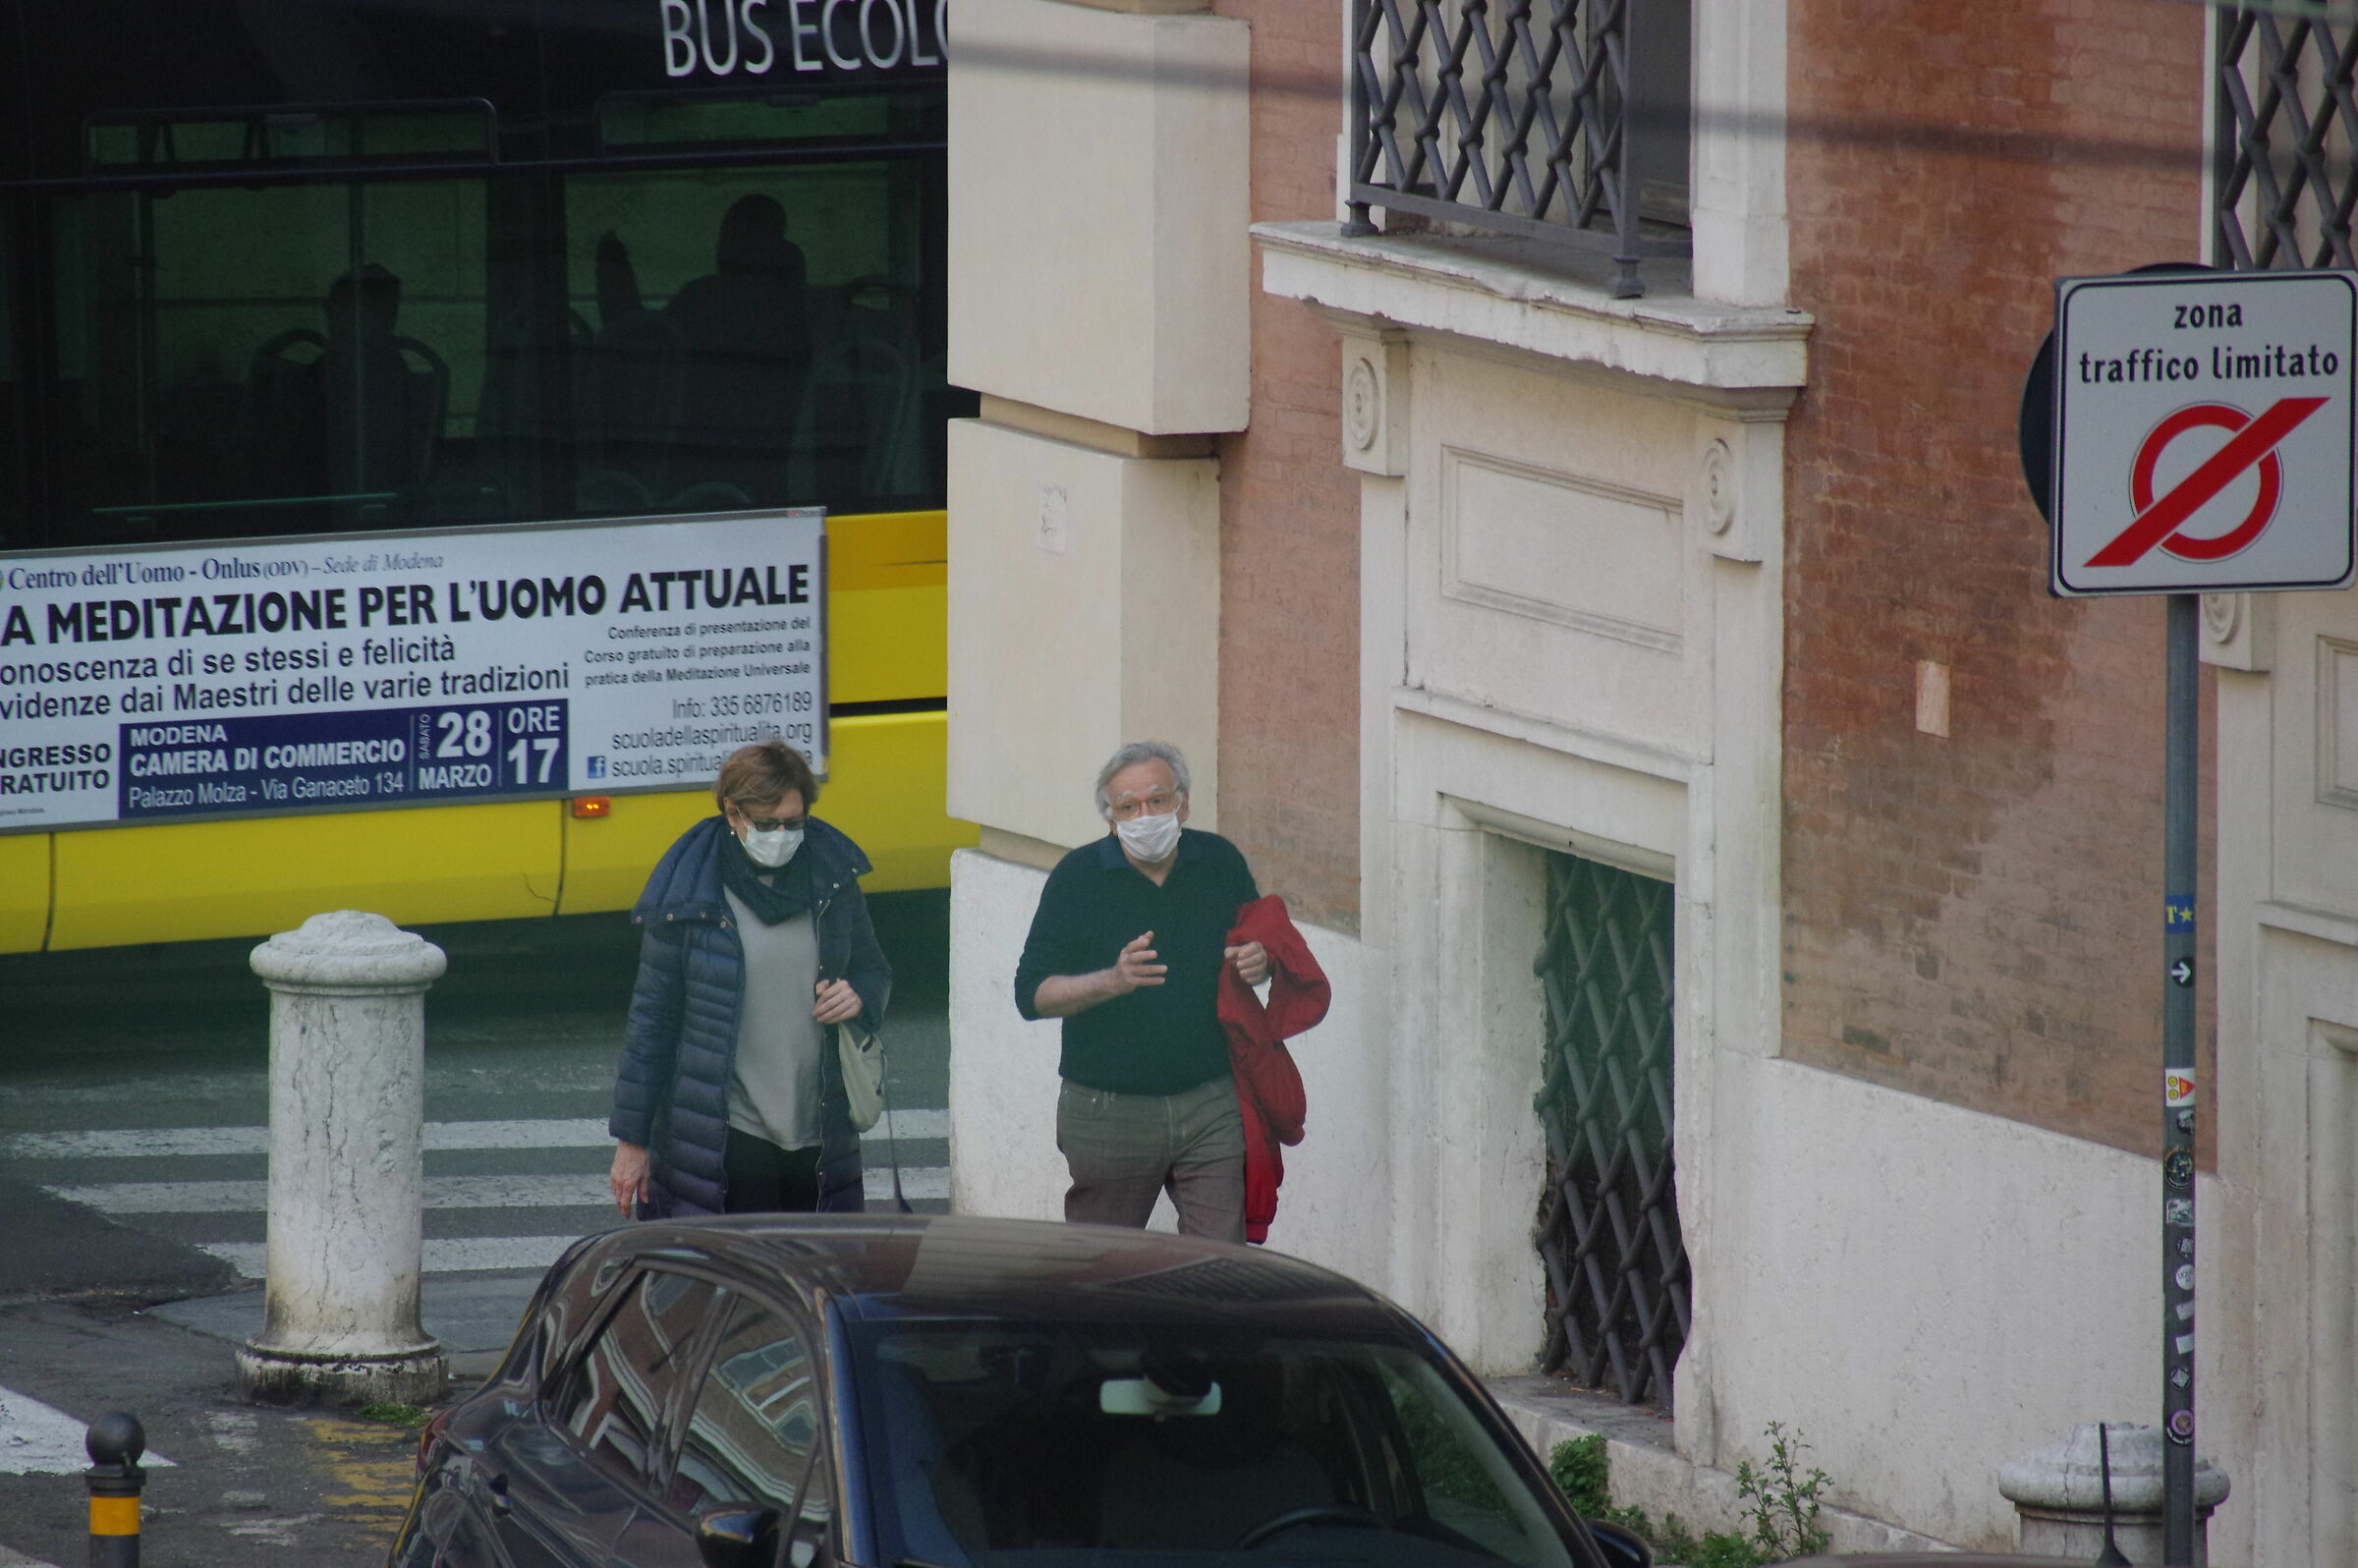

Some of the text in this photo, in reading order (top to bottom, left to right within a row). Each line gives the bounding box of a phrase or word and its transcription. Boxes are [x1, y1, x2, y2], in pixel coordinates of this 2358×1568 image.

[659, 0, 774, 78] BUS
[2173, 303, 2244, 329] zona
[2079, 344, 2339, 383] traffico limitato
[9, 567, 77, 589] Centro
[202, 557, 260, 581] Onlus
[263, 559, 309, 580] (ODV)
[322, 555, 360, 574] Sede
[364, 552, 378, 572] di
[382, 551, 443, 572] Modena
[47, 588, 347, 644] MEDITAZIONE
[359, 584, 438, 627] PER
[449, 575, 607, 623] L'UOMO
[619, 564, 810, 613] ATTUALE
[607, 616, 811, 640] Conferenza di presentazione del
[168, 648, 193, 676] di
[203, 652, 236, 675] se
[245, 642, 328, 673] stessi
[338, 645, 354, 667] e
[363, 634, 455, 666] felicità
[584, 639, 811, 664] Corso gratuito di preparazione alla
[121, 685, 163, 713] dai
[174, 679, 278, 710] Maestri
[288, 676, 355, 704] delle
[364, 671, 431, 700] varie
[441, 662, 569, 696] tradizioni
[585, 661, 811, 688] pratica della Meditazione Universale
[507, 705, 561, 734] ORE
[672, 691, 813, 719] Info: 335 6876189
[130, 724, 228, 747] MODENA
[419, 713, 431, 759] SABATO
[436, 709, 491, 758] 28
[612, 721, 814, 750] scuoladellaspiritualita.org
[130, 738, 406, 777] CAMERA DI COMMERCIO
[418, 763, 492, 790] MARZO
[507, 738, 560, 785] 17
[129, 786, 195, 809] Palazzo
[197, 781, 247, 804] Molza
[260, 777, 288, 800] Via
[292, 774, 370, 799] Ganaceto
[374, 770, 404, 794] 134
